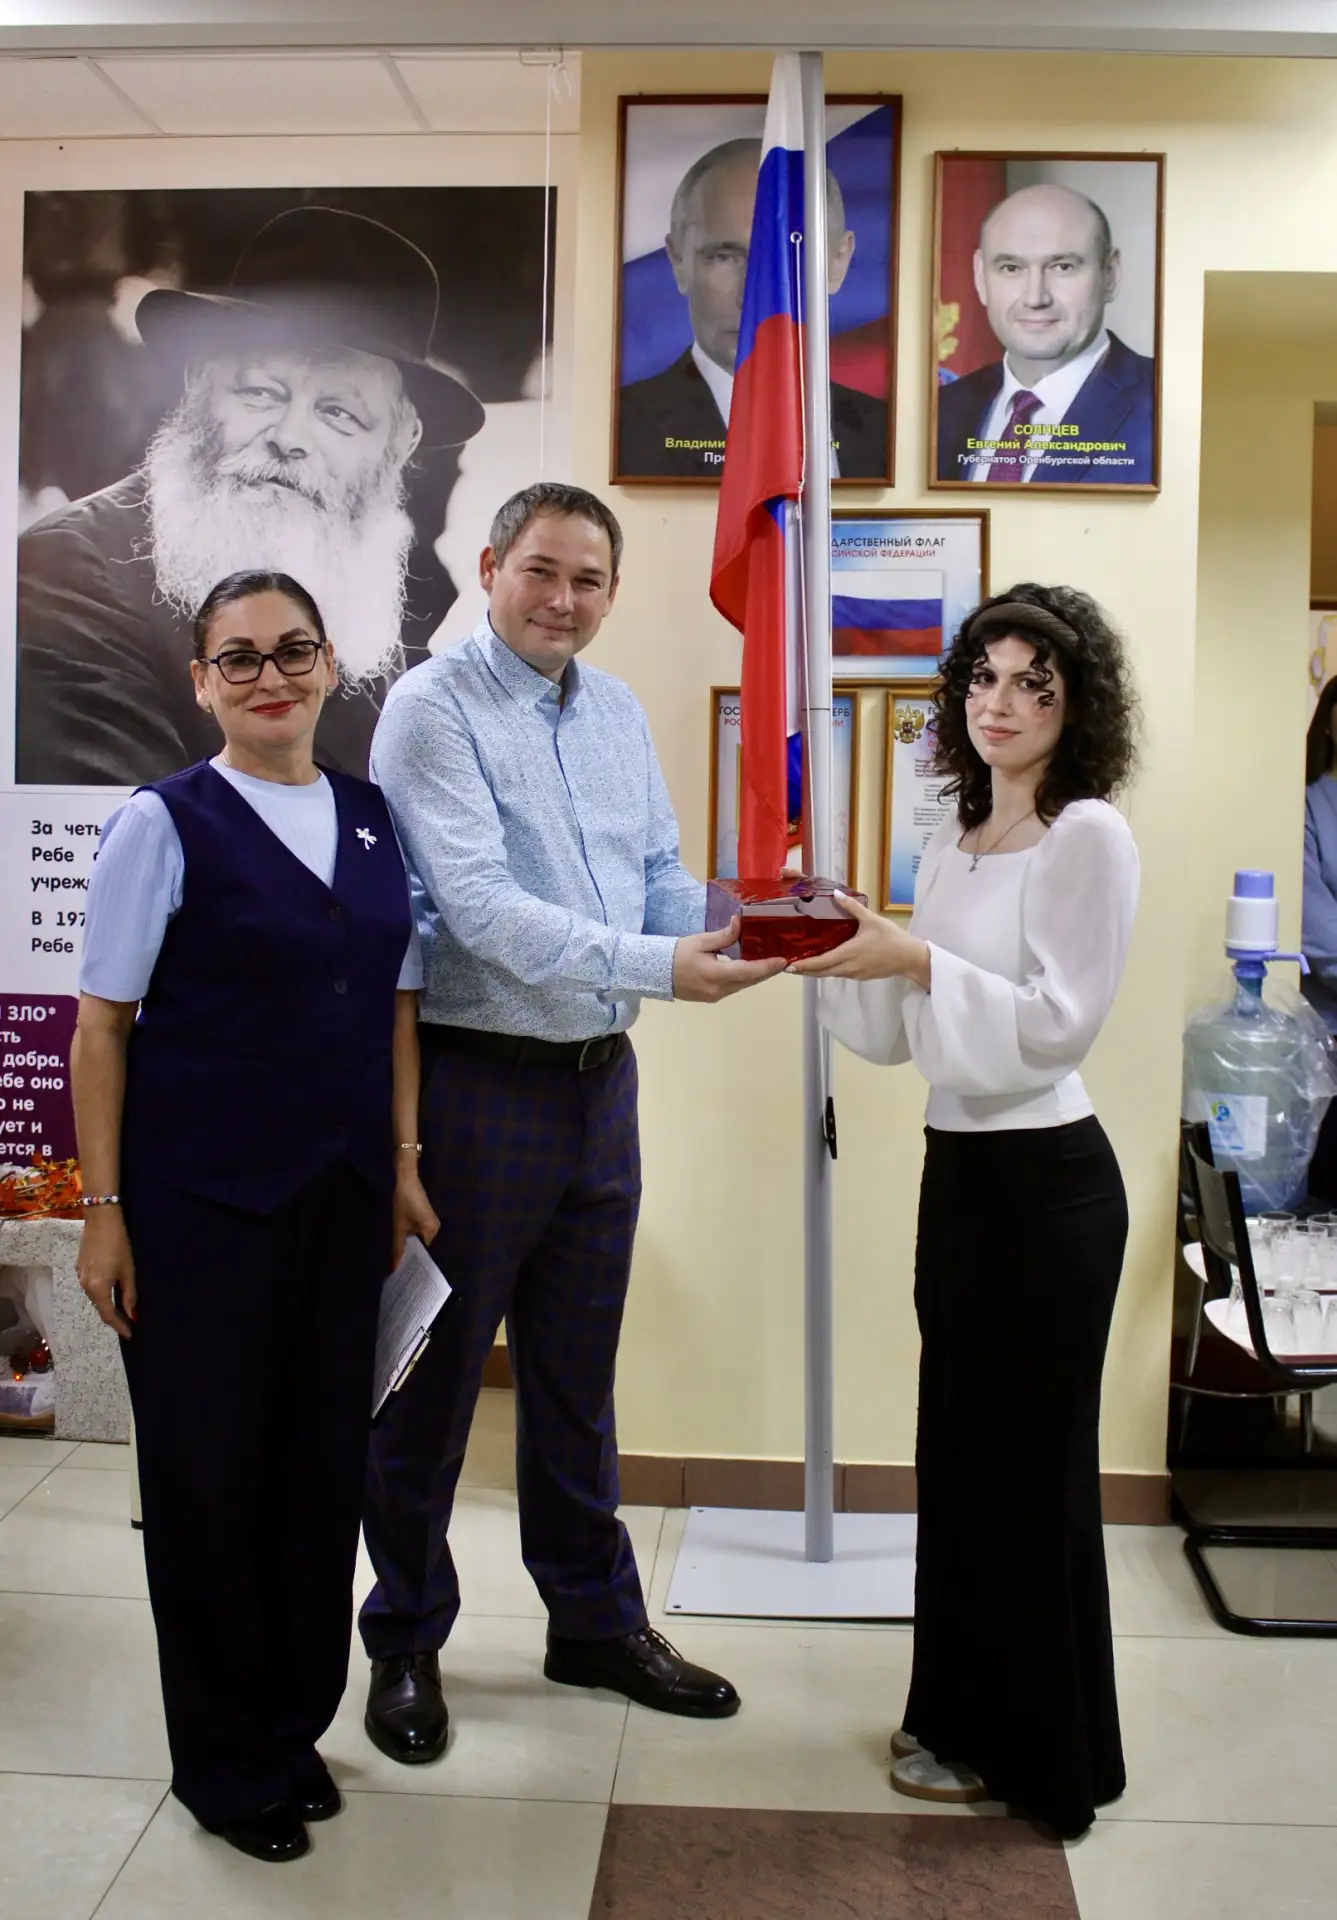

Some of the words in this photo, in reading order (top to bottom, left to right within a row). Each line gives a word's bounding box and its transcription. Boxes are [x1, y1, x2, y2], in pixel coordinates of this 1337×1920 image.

[1013, 424, 1080, 437] СОЛНЦЕВ
[967, 438, 1021, 449] Евгений
[1024, 438, 1127, 452] Александрович
[957, 454, 1016, 465] Губернатор
[1019, 454, 1091, 466] Оренбургской
[1092, 455, 1135, 466] области
[915, 537, 946, 547] ФЛАГ
[880, 549, 936, 558] ФЕДЕРАЦИИ
[31, 820, 53, 835] За
[31, 846, 74, 862] Ребе
[31, 911, 42, 926] В
[31, 938, 74, 953] Ребе
[3, 1050, 65, 1071] добра.
[30, 1077, 64, 1090] оно
[12, 1098, 35, 1111] не
[31, 1122, 42, 1134] и
[42, 1144, 52, 1157] в
